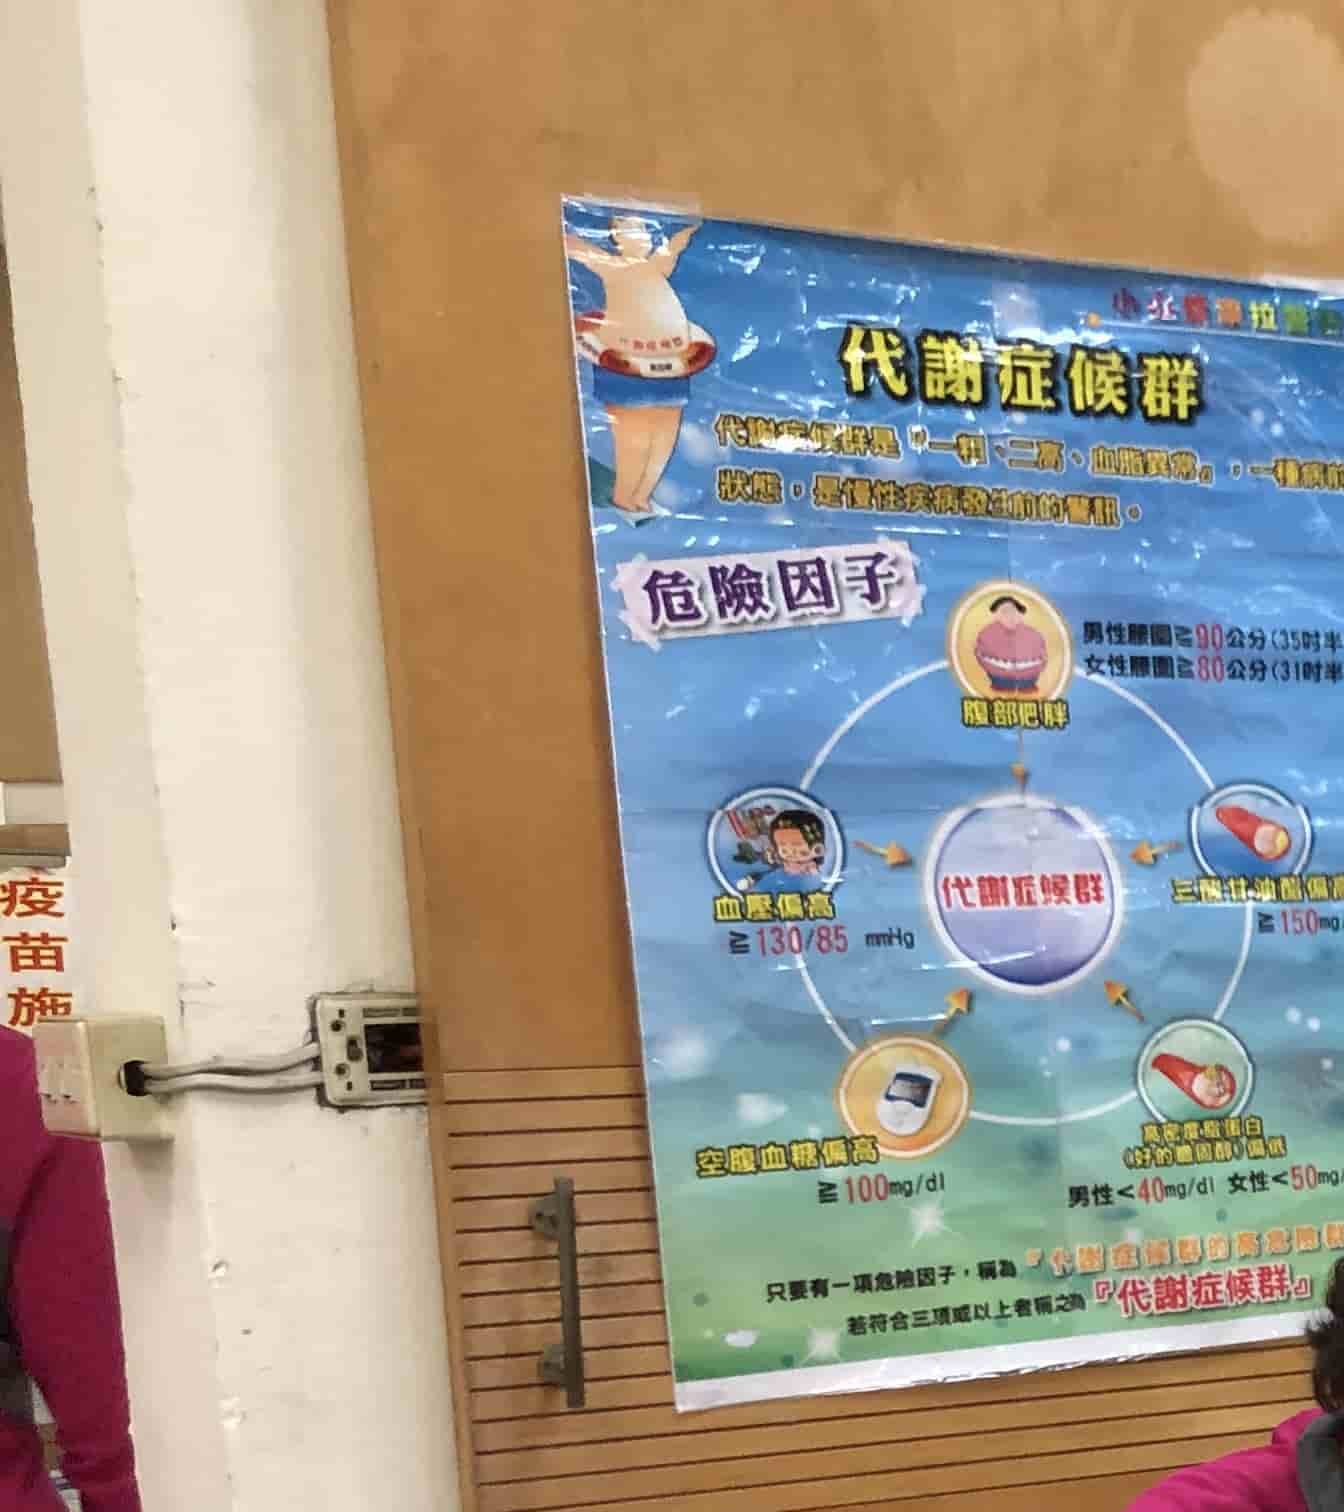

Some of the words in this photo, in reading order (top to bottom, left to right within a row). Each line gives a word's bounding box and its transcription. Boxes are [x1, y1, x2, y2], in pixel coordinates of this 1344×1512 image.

[838, 324, 1206, 423] 代謝症候群
[642, 550, 904, 629] 危險因子
[961, 697, 1069, 730] 腹部肥胖
[713, 890, 837, 923] 血壓偏高
[942, 873, 1105, 909] 代謝症候群
[0, 876, 73, 1026] 疫苗施
[864, 927, 915, 950] mmHg
[1141, 1116, 1264, 1145] 高密度脂蛋白
[696, 1135, 880, 1179] 空腹血糖偏高
